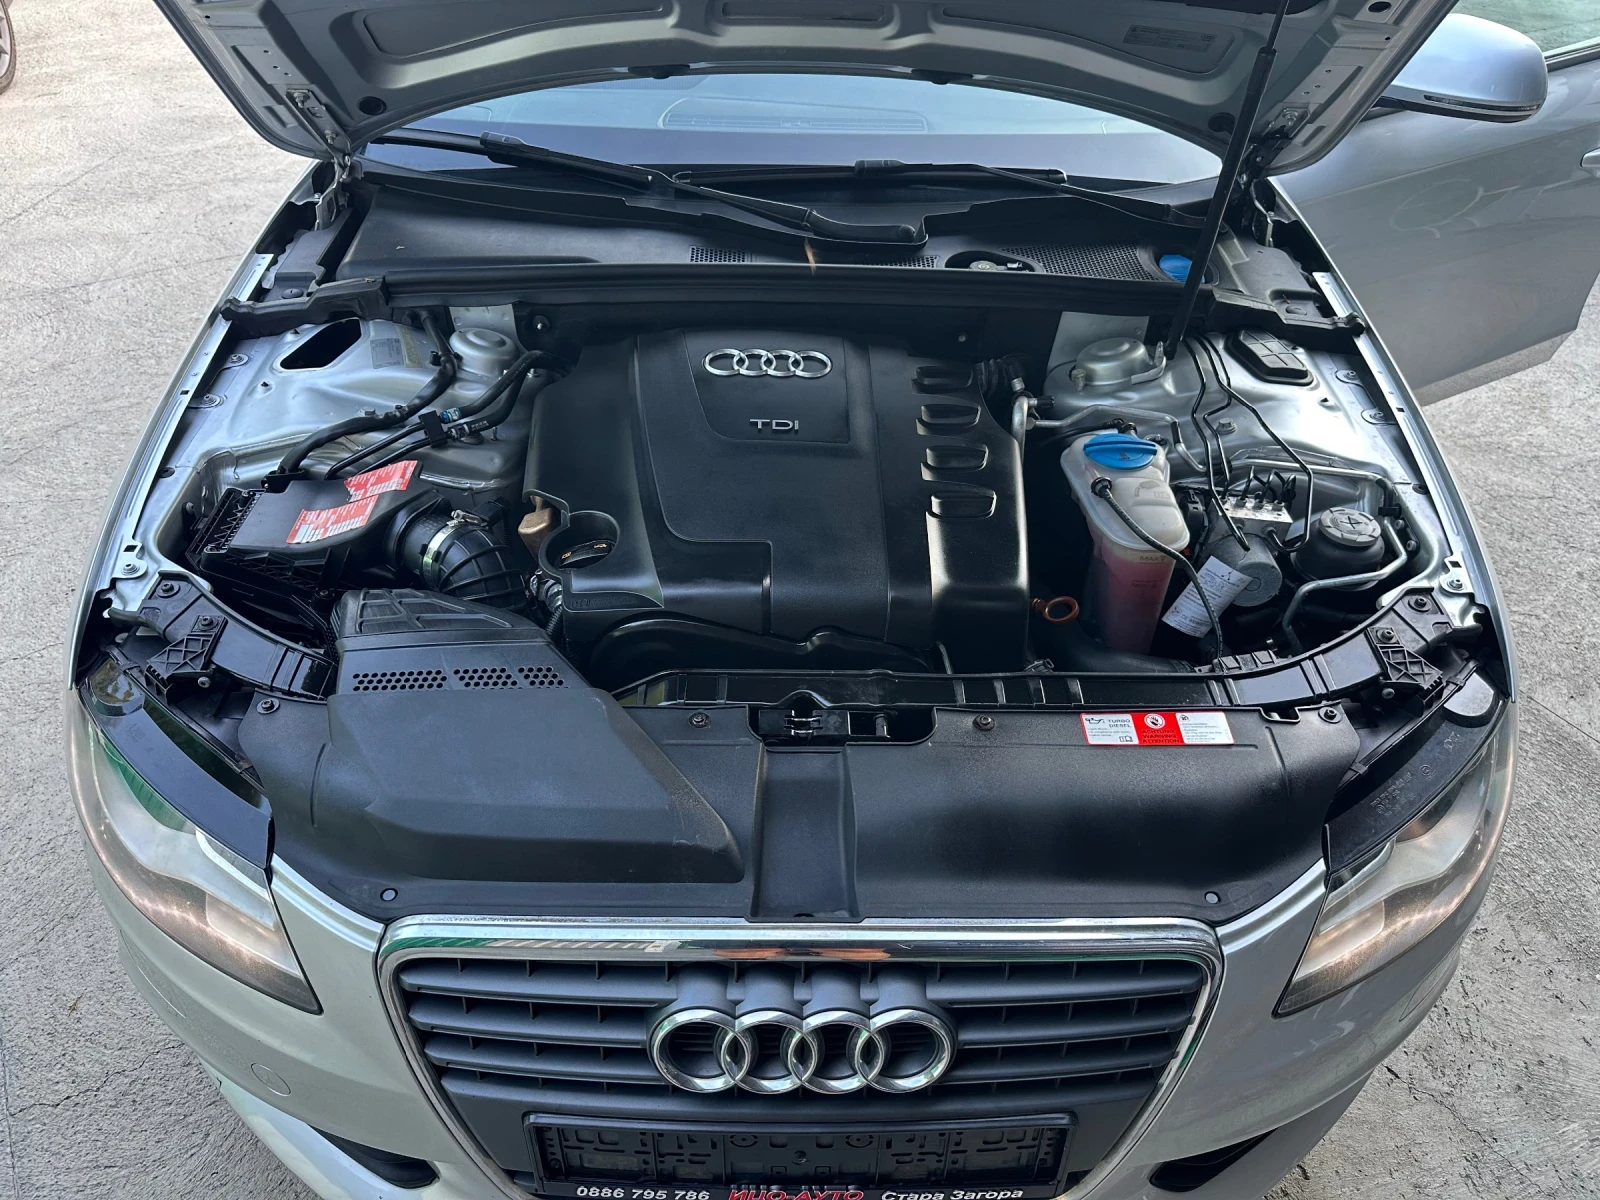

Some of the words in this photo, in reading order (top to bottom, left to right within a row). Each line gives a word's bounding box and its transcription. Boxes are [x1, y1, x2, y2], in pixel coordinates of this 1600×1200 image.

[749, 418, 799, 430] TDI
[576, 1186, 625, 1198] 0886
[631, 1188, 668, 1200] 795
[674, 1190, 710, 1200] 786
[881, 1191, 945, 1200] Стара
[950, 1190, 1023, 1200] Загора
